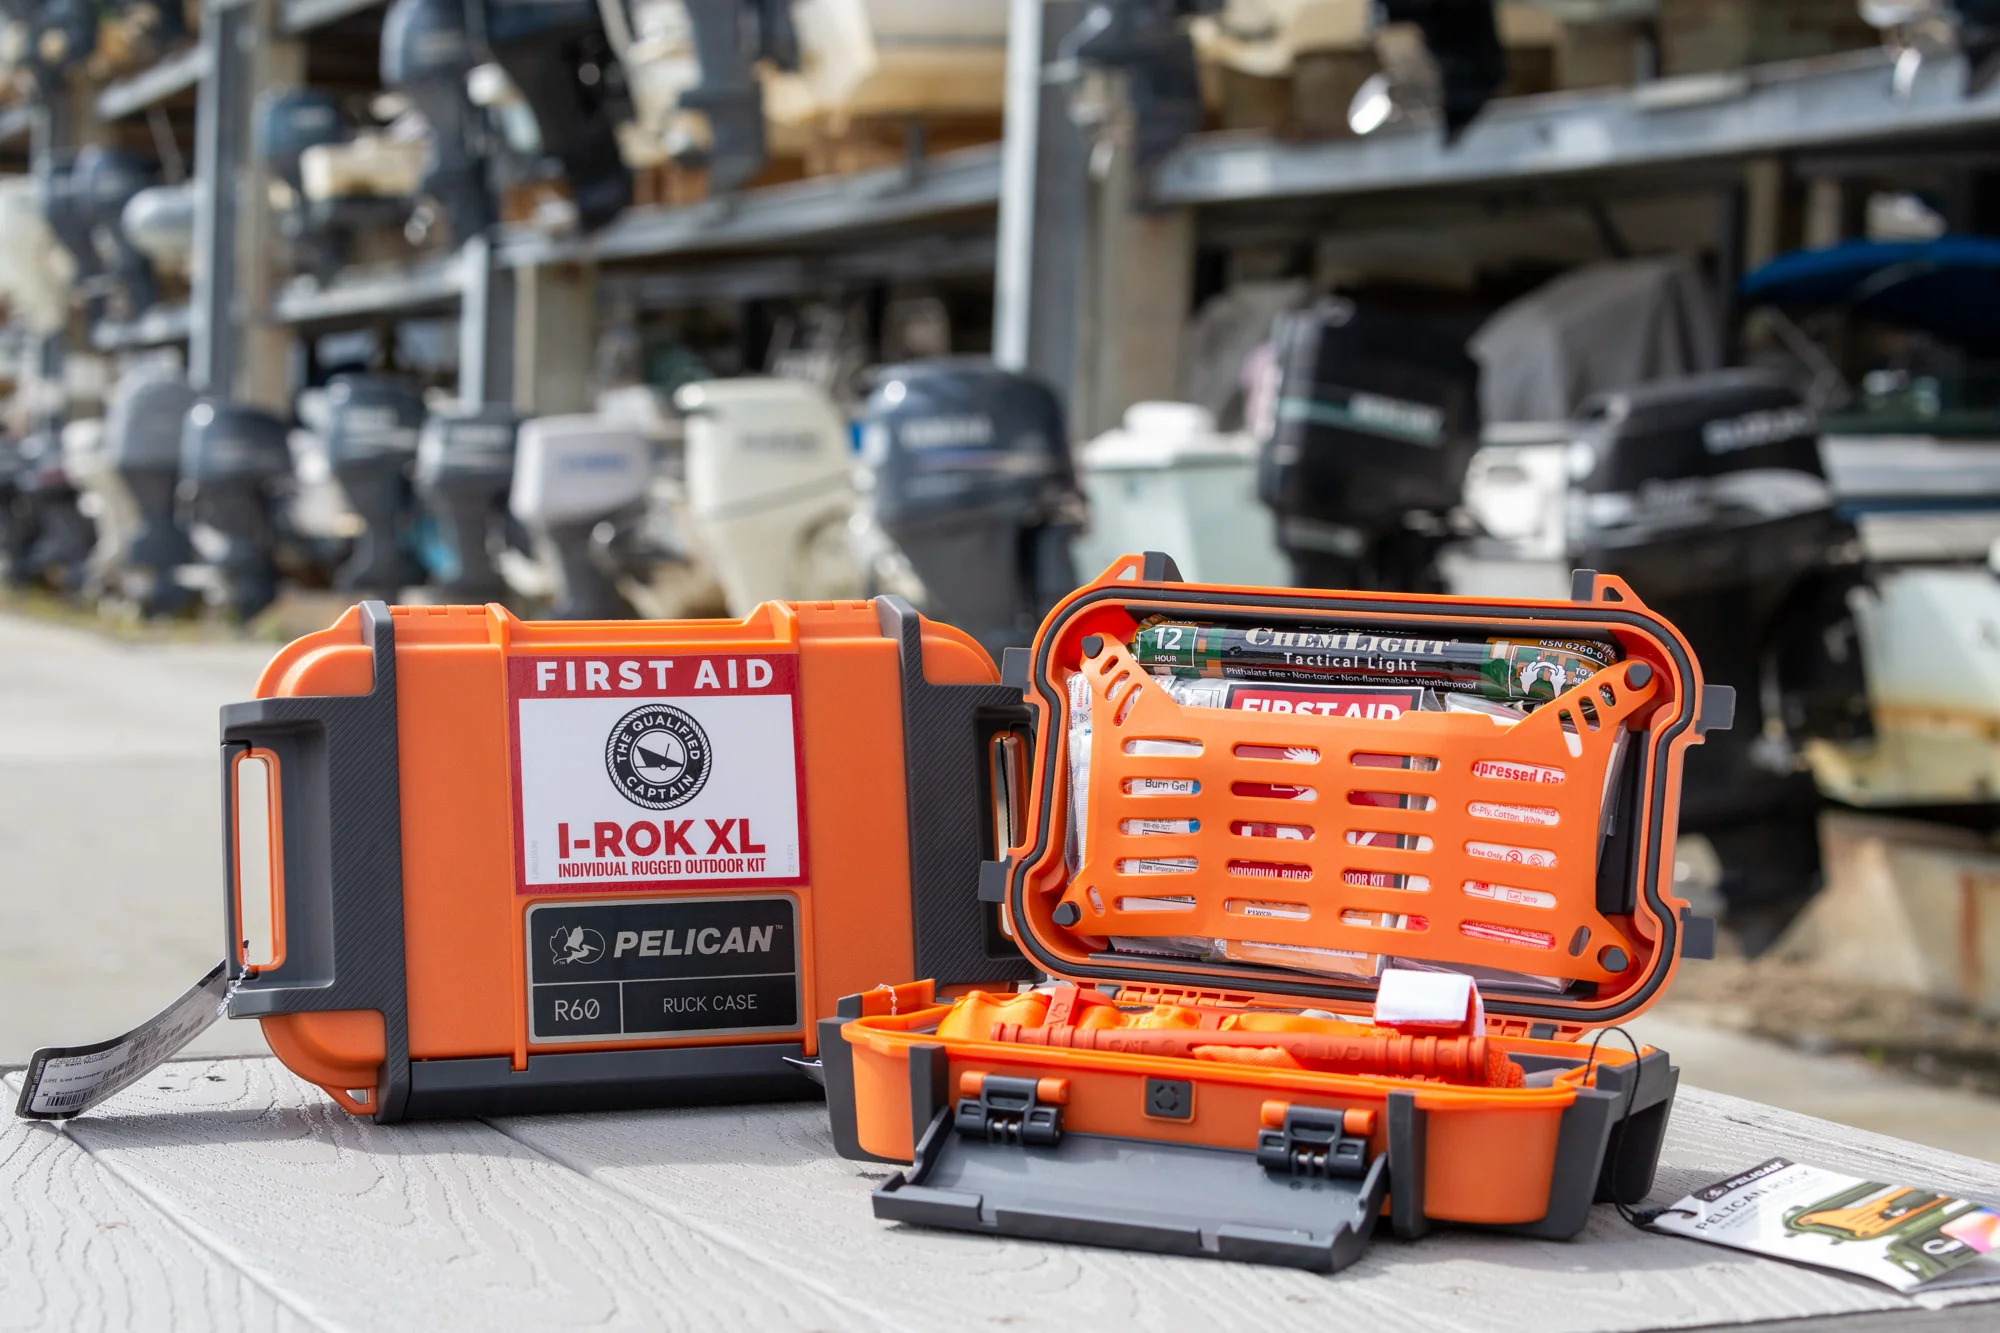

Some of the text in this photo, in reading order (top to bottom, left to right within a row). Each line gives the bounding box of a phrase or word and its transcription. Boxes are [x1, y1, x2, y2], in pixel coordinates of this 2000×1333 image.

[1154, 627, 1183, 650] 12
[1539, 639, 1563, 648] NSN
[1154, 654, 1177, 662] HOUR
[1284, 652, 1417, 673] Tactical Light
[536, 659, 773, 691] FIRST AID
[1226, 667, 1476, 689] Phthalate free Non-toxic Non-flammable Weatherproof
[1575, 667, 1587, 676] TO
[1345, 703, 1400, 720] AID
[617, 715, 700, 763] THE QUALIFIED
[627, 774, 694, 799] CAPTAIN
[1145, 778, 1189, 791] Burn Gel
[558, 818, 766, 859] I-ROK XL
[1472, 848, 1485, 856] Use
[1487, 851, 1504, 860] Only
[558, 860, 628, 878] INDIVIDUAL
[631, 858, 682, 876] RUGGED
[685, 857, 744, 874] OUTDOOR
[747, 857, 766, 873] KIT
[1370, 874, 1385, 887] KIT
[554, 998, 600, 1022] R60
[663, 994, 758, 1013] RUCK CASE
[1726, 1160, 1784, 1189] PELICAN
[1695, 1188, 1769, 1230] PELICAN
